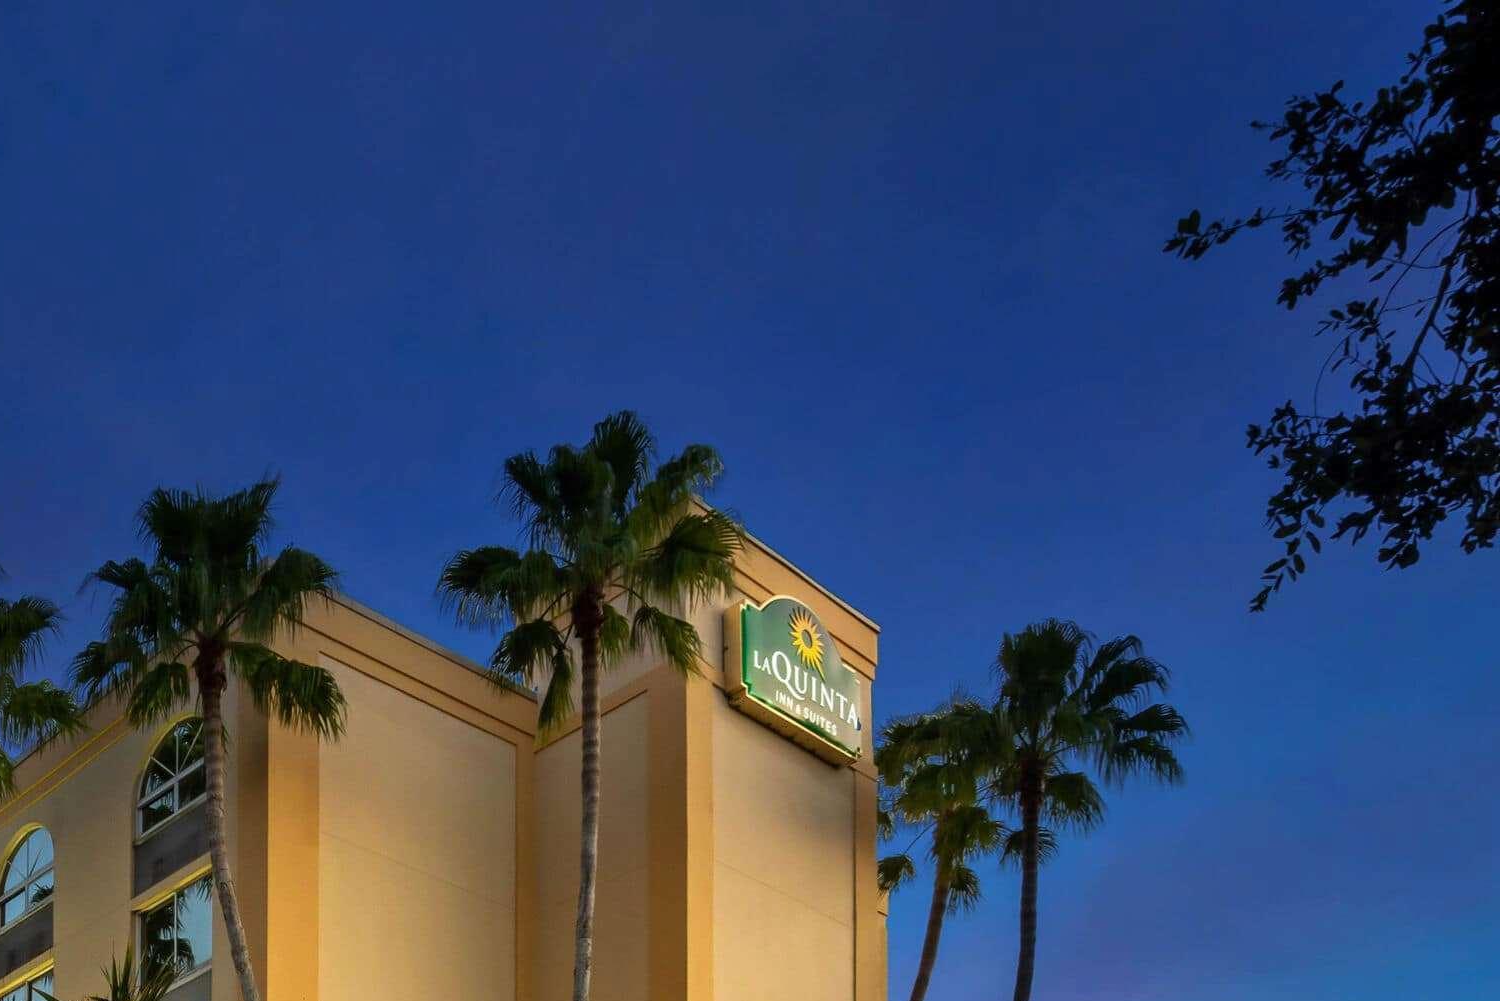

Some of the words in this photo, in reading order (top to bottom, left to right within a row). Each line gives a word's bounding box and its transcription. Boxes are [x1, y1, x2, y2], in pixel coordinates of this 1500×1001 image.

[771, 651, 860, 730] QUINTA
[775, 690, 793, 711] INN
[804, 707, 838, 736] SUITES
